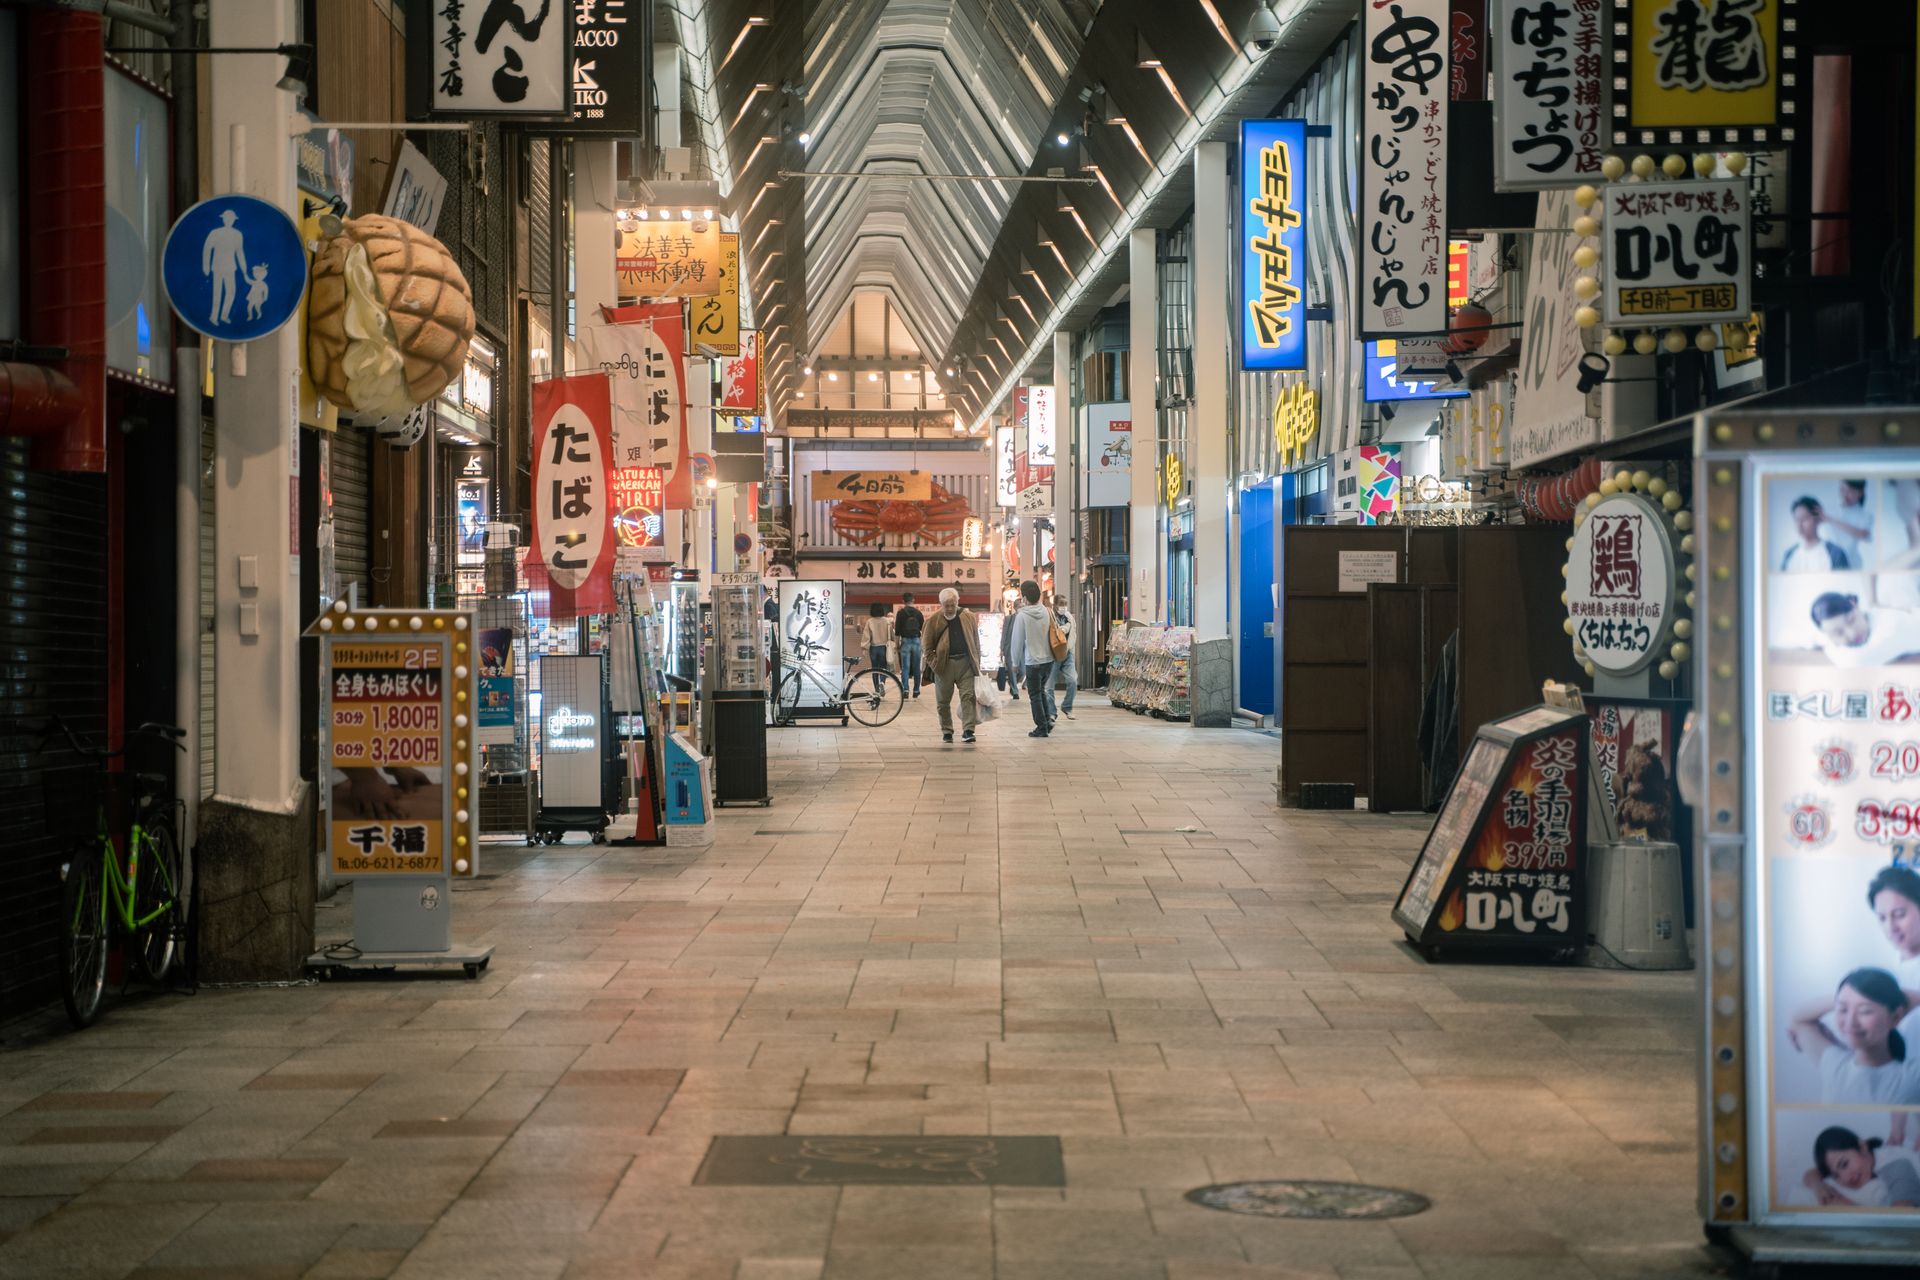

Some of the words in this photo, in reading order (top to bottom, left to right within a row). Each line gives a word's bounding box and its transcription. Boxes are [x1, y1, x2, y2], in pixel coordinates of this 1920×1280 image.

[1371, 5, 1443, 309] 串かつじゃんじゃん
[1420, 100, 1442, 276] 串かつ・どて焼専門店
[1613, 189, 1740, 217] 大阪下町焼鳥
[633, 234, 695, 259] 法善寺
[1255, 144, 1297, 344] マツモトキヨシ
[1624, 288, 1733, 310] 千日前一丁目店
[458, 489, 480, 499] No.1
[551, 423, 594, 570] たばこ
[836, 473, 905, 496] 千日前
[1595, 519, 1638, 593] 鶏
[1578, 618, 1650, 652] くちはっちょう
[404, 649, 438, 669] 2F
[336, 674, 438, 697] 全身もみほぐし
[335, 711, 364, 725] 30分
[373, 706, 439, 731] 1,800円
[1601, 708, 1616, 736] 名物
[335, 743, 364, 757] 60分
[372, 737, 439, 763] 3,200円
[1504, 790, 1530, 827] 名物
[350, 825, 425, 854] 千福
[1504, 842, 1567, 868] 399円
[1468, 871, 1571, 890] 大阪下町焼鳥
